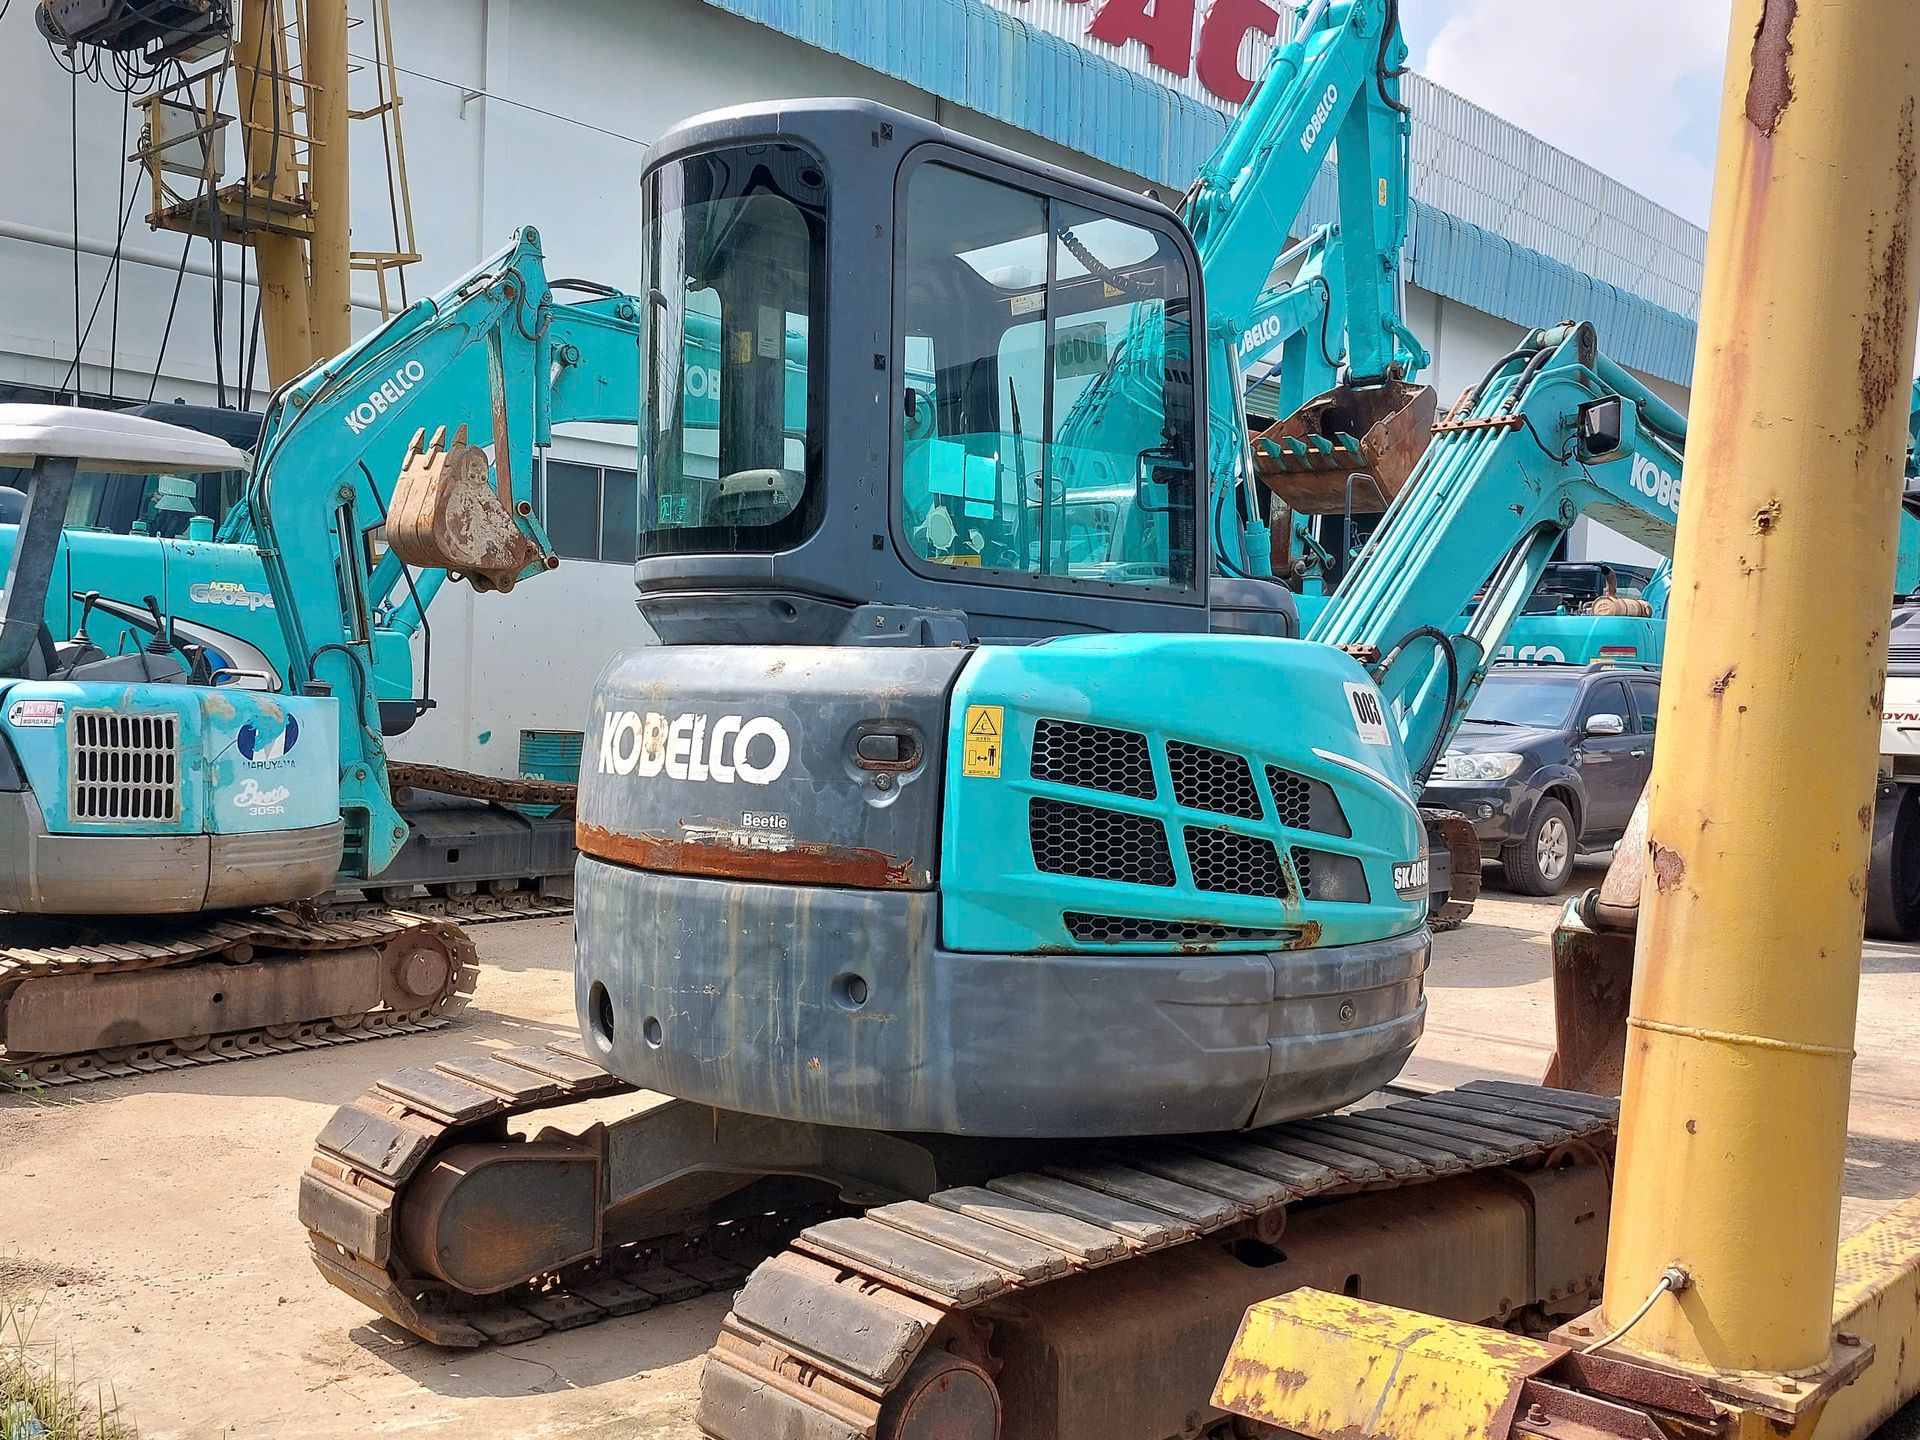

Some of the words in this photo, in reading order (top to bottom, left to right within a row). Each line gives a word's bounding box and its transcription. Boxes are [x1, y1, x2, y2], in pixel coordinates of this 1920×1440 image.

[1299, 83, 1338, 154] KOBELCO
[343, 360, 425, 435] KOBELCO
[209, 581, 246, 593] ACERA
[1352, 690, 1382, 726] 003
[1881, 712, 1920, 721] DYN
[598, 710, 791, 786] KOBELCO
[249, 805, 285, 816] 30SR
[742, 813, 788, 829] Beetle
